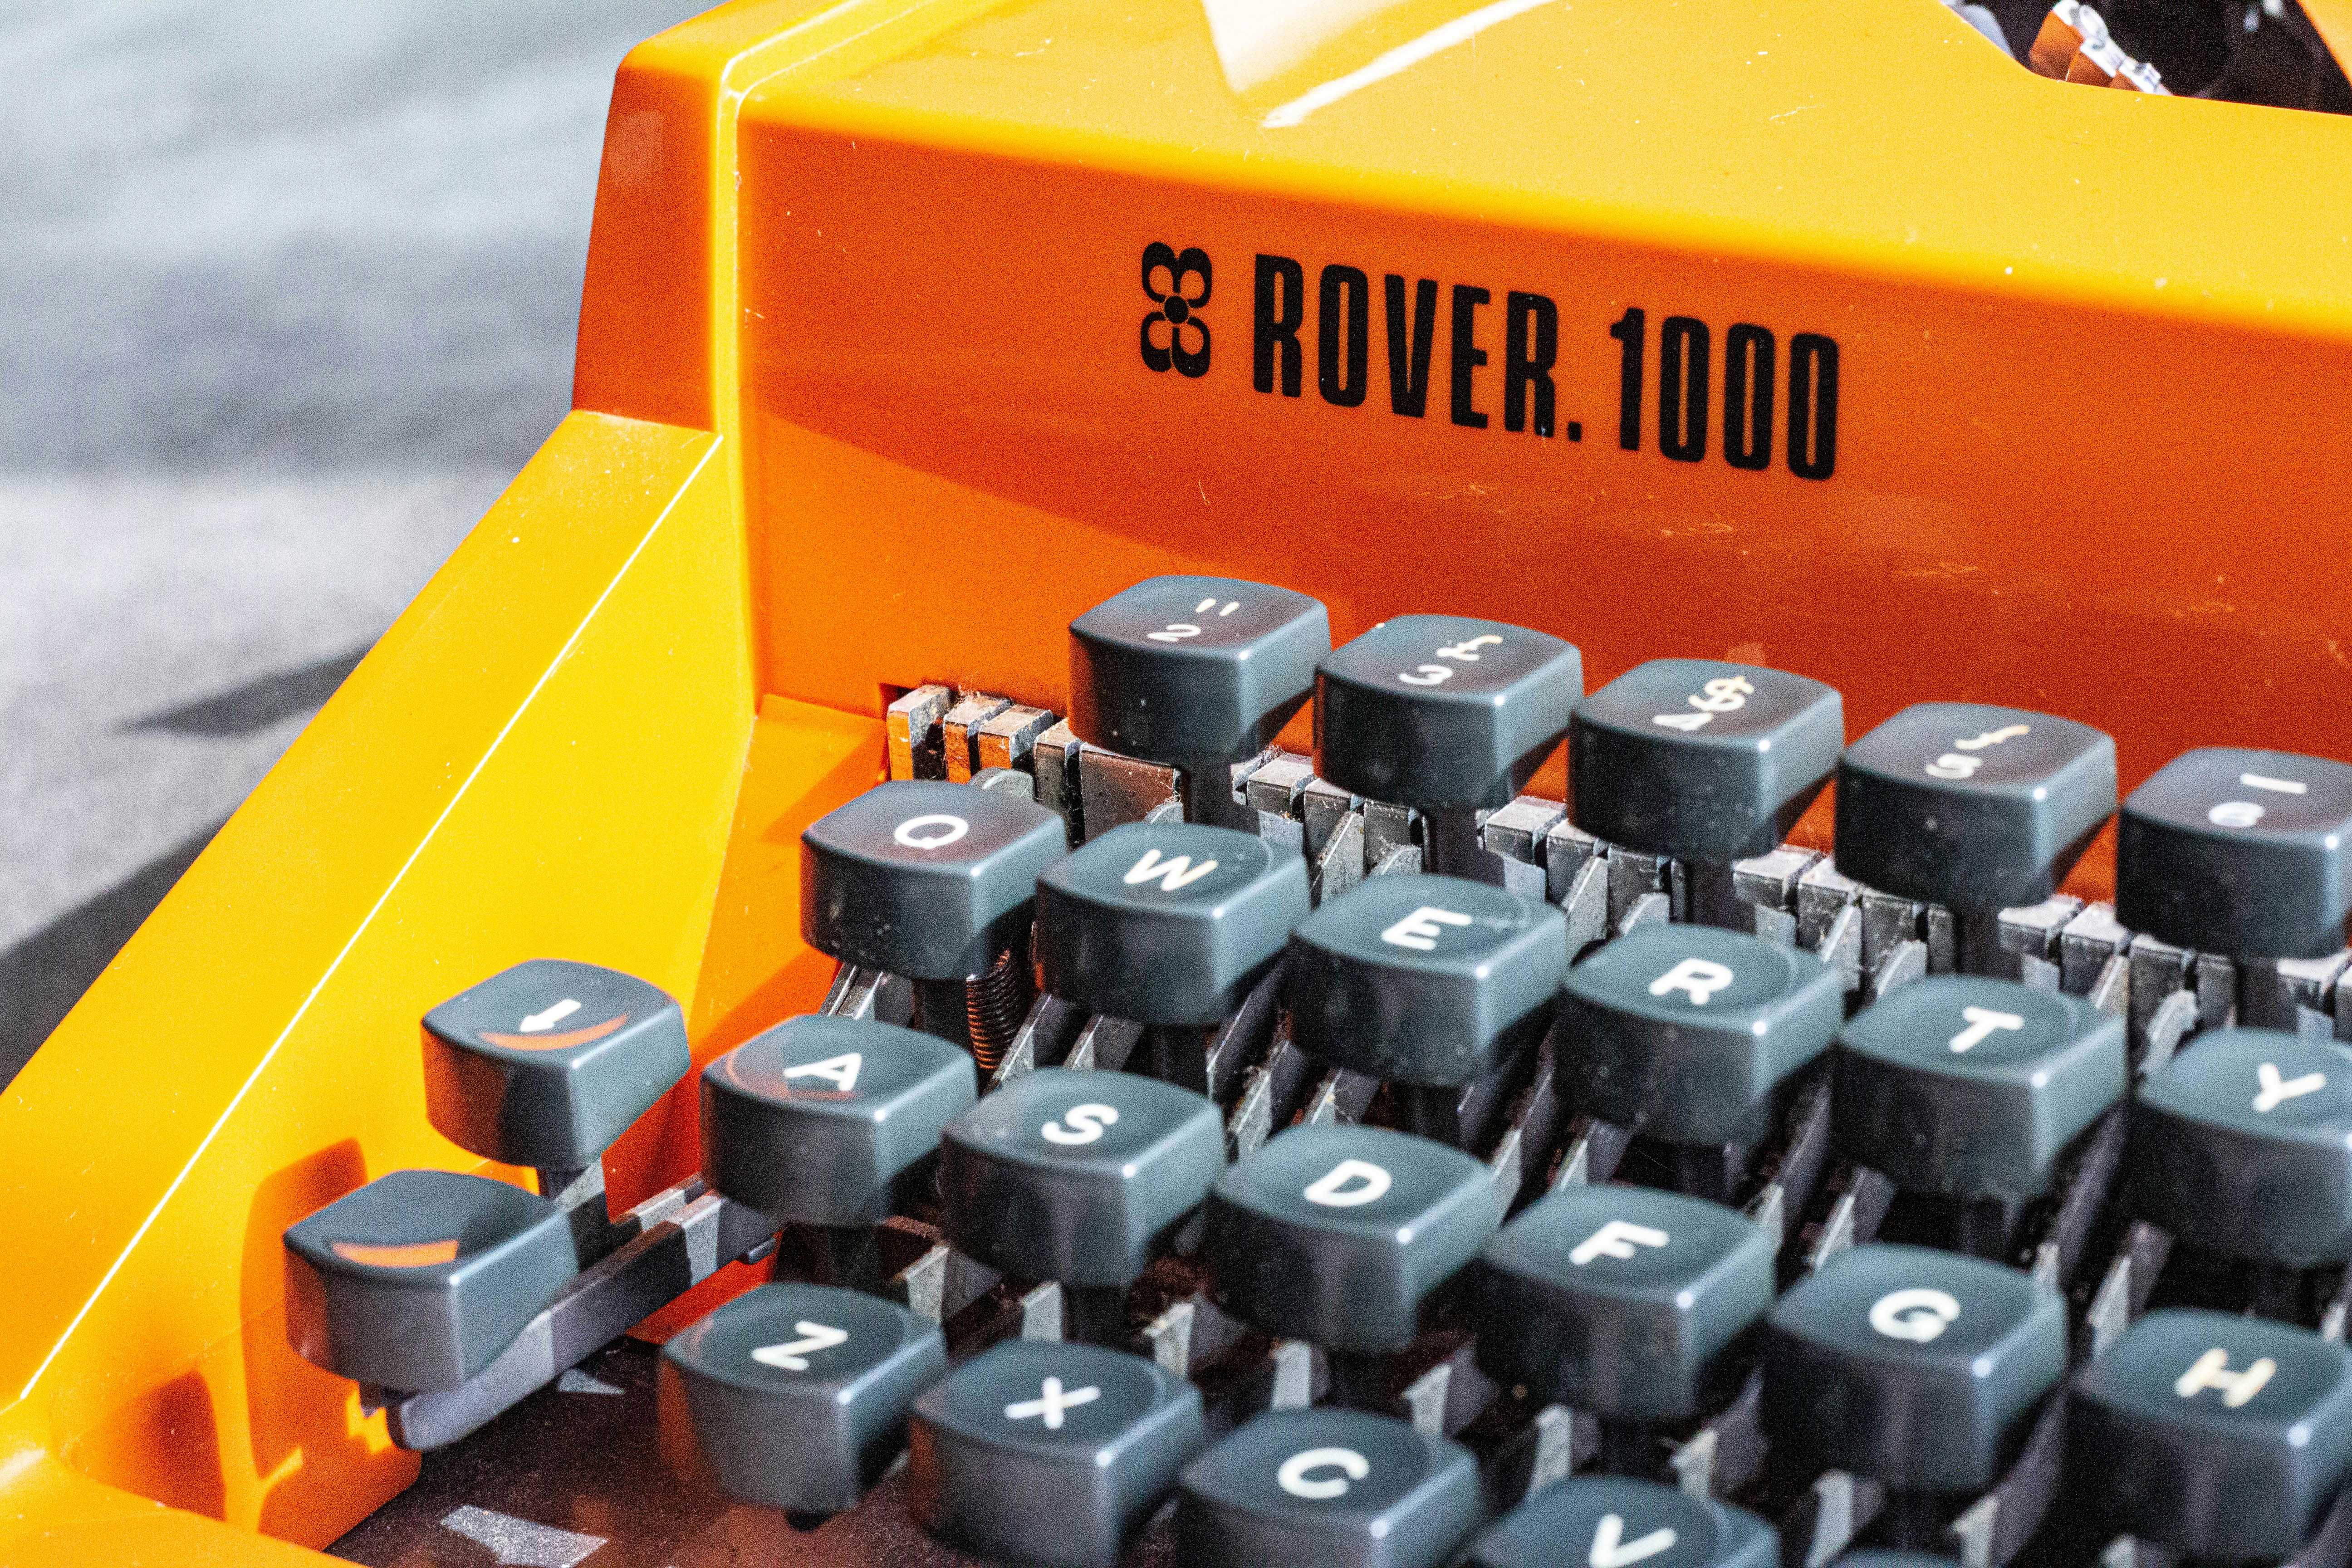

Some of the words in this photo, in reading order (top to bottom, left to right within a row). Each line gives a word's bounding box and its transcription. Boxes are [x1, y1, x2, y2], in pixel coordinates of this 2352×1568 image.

[1253, 253, 1583, 443] ROVER.
[1609, 307, 1840, 482] 1000
[1147, 623, 1202, 642] 2
[1399, 664, 1453, 686] 3
[1688, 675, 1755, 712] $
[1652, 711, 1714, 732] 4
[1926, 754, 1980, 778] 5
[893, 813, 969, 850] Q
[1123, 848, 1218, 892] W
[1381, 906, 1473, 950] E
[1649, 957, 1734, 1005] R
[1950, 1006, 2024, 1053] T
[783, 1052, 862, 1092] A
[2254, 1063, 2325, 1112] Y
[1041, 1103, 1119, 1145] S
[1304, 1159, 1391, 1206] D
[1570, 1220, 1668, 1264] F
[1870, 1289, 1959, 1341] G
[752, 1320, 848, 1371] Z
[2176, 1348, 2275, 1406] H
[1005, 1377, 1099, 1429] X
[1278, 1448, 1368, 1498] C
[1589, 1514, 1675, 1568] V
